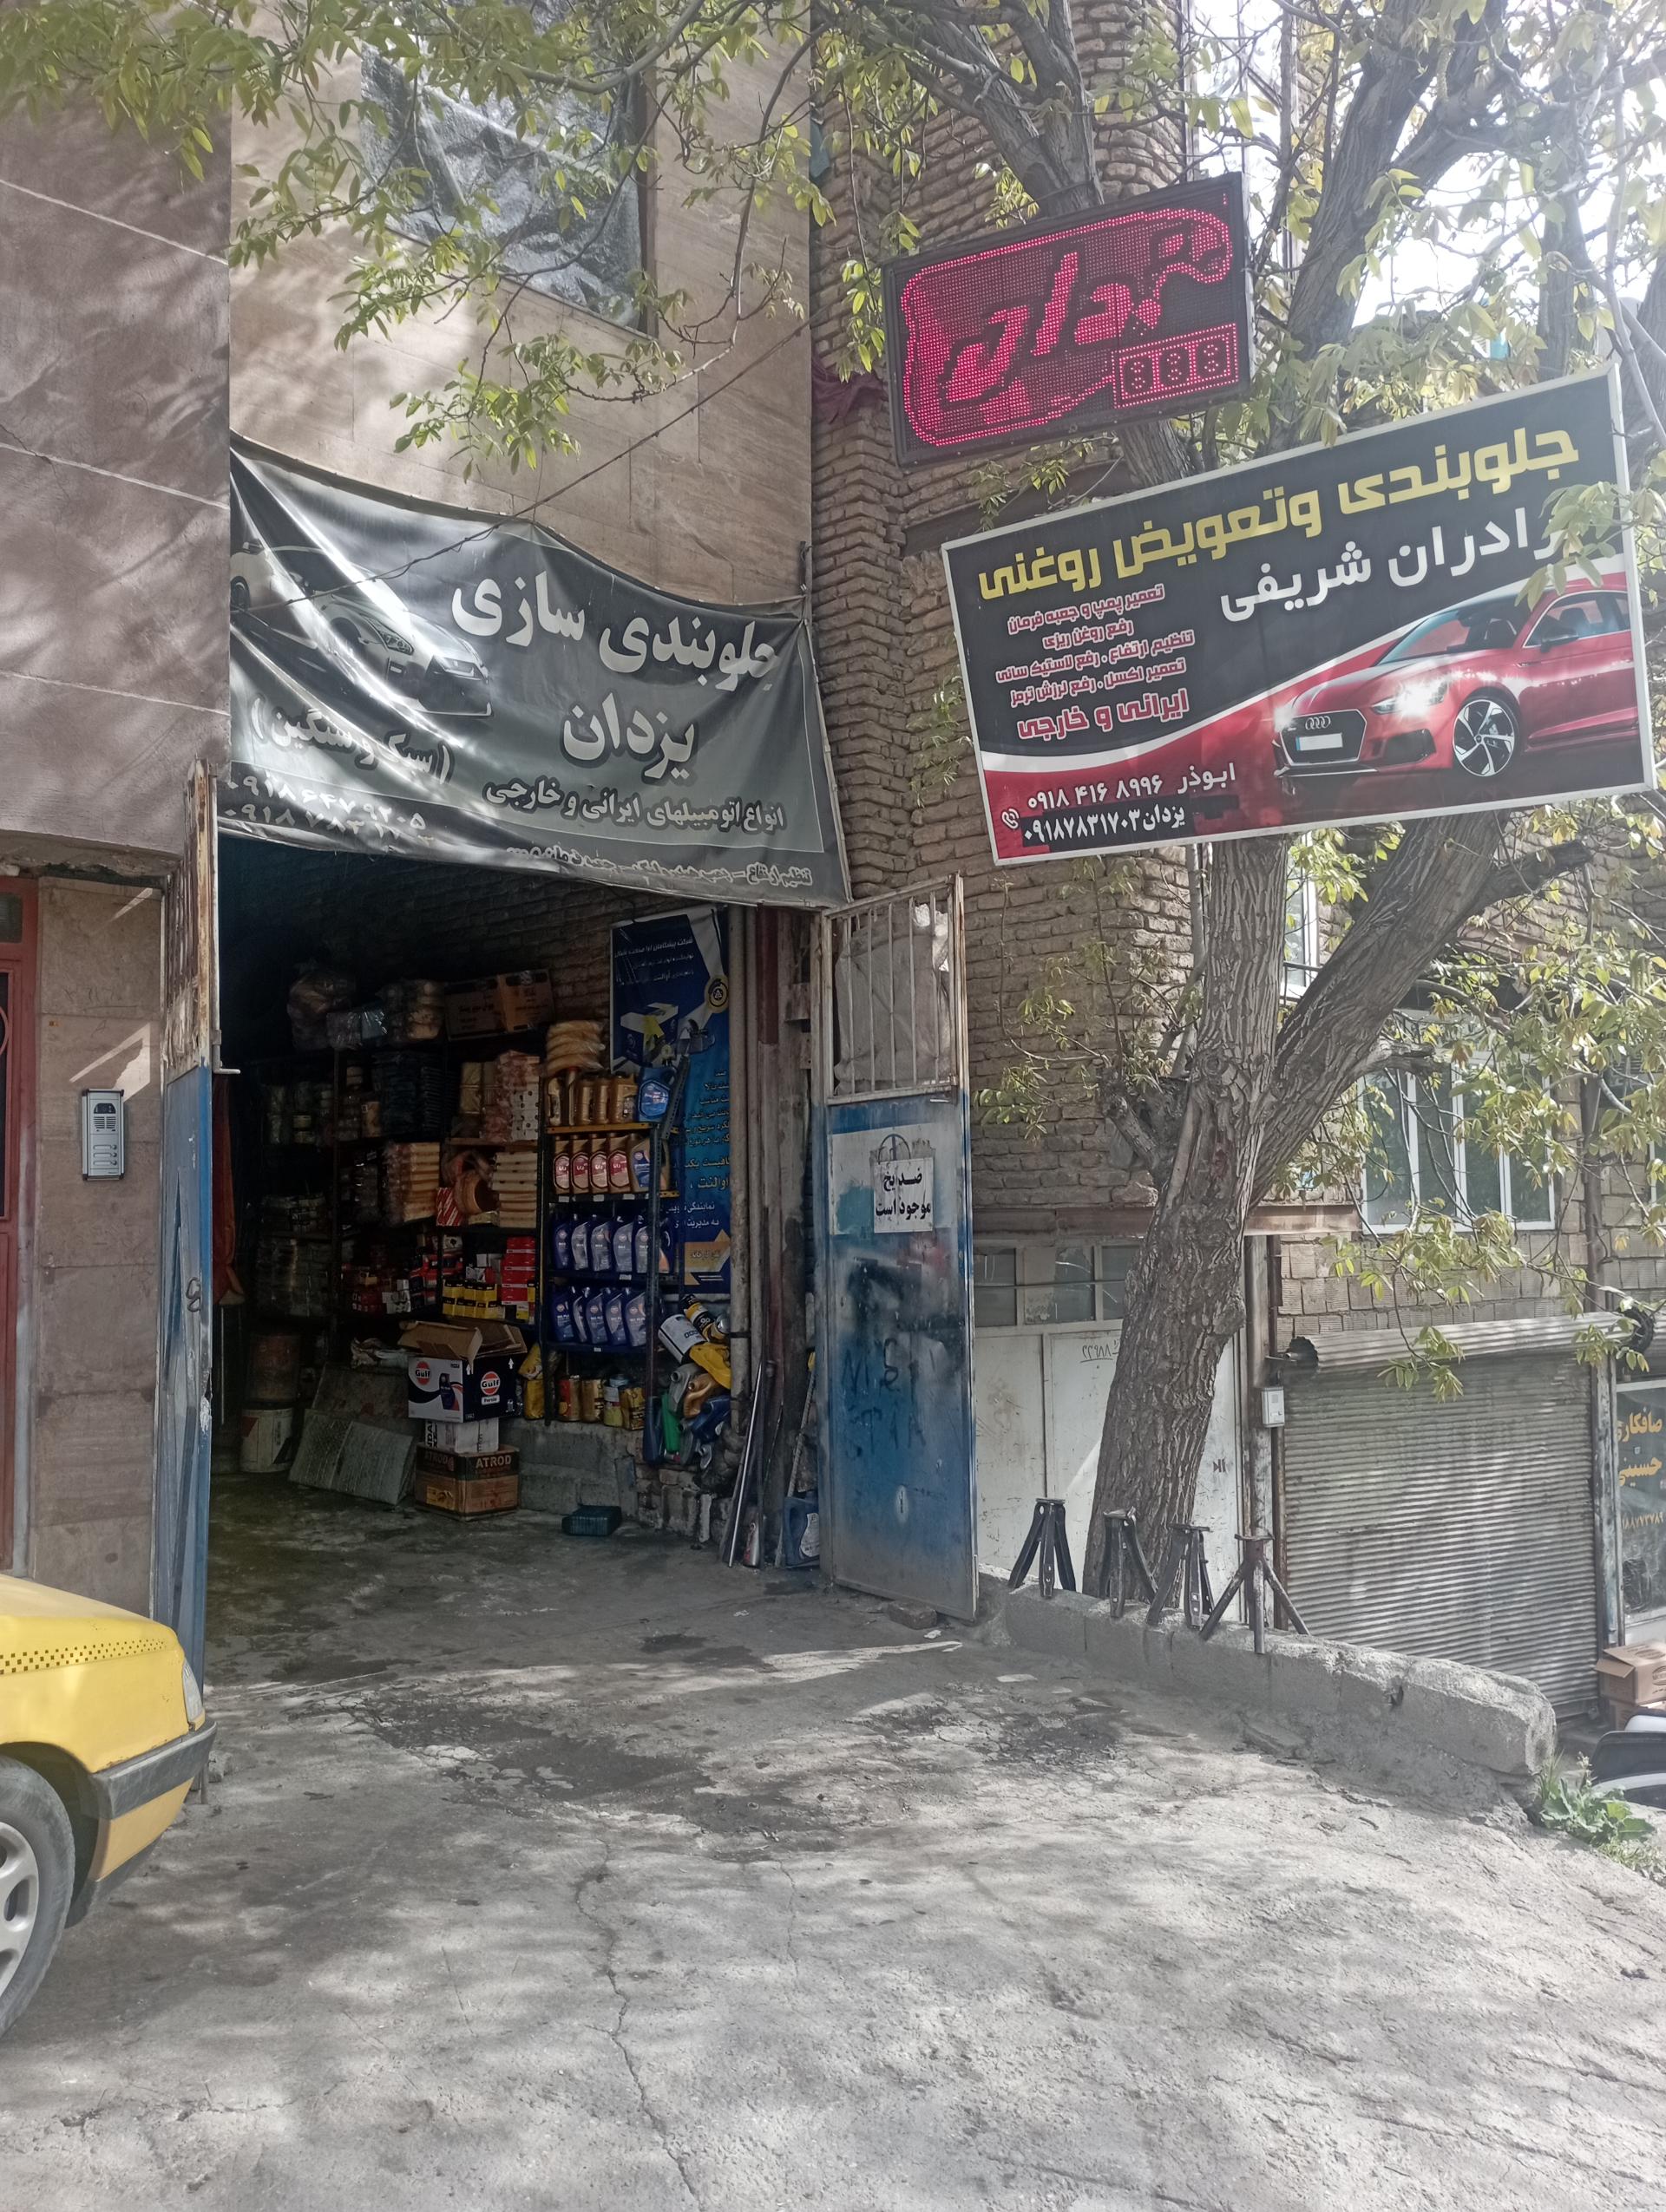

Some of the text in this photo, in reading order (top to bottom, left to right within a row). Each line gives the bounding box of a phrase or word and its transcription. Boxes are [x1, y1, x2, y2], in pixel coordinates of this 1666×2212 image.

[1338, 428, 1579, 514] جلوبندی
[978, 546, 1102, 600] روغنی
[1221, 507, 1583, 623] رادران شریفی
[1007, 583, 1165, 635] تعمیر پمپ و جعبه فرمان
[451, 570, 779, 692] جلوبندی سازی
[1042, 618, 1134, 650] رفع روغن ریزی
[1151, 629, 1195, 654] تنظیم
[1030, 655, 1073, 677] لاستیک
[1075, 651, 1101, 670] رفع
[1109, 639, 1150, 664] ارتفاع
[1010, 657, 1187, 708] تعمیر اکسل رفع لرزش ترمز
[1017, 687, 1190, 741] ایرانی و خارجی
[563, 692, 695, 779] یزدان
[485, 779, 561, 810] خارجی
[1027, 762, 1236, 810] ابوذر ۰۹۱۸ ۴۱۶ ۸۹۹۶
[563, 792, 578, 817] و
[581, 790, 641, 823] ایرانی
[743, 805, 784, 832] انواع
[416, 1369, 430, 1378] Gulf
[482, 1379, 499, 1389] Gulf
[476, 1455, 512, 1469] ATROD
